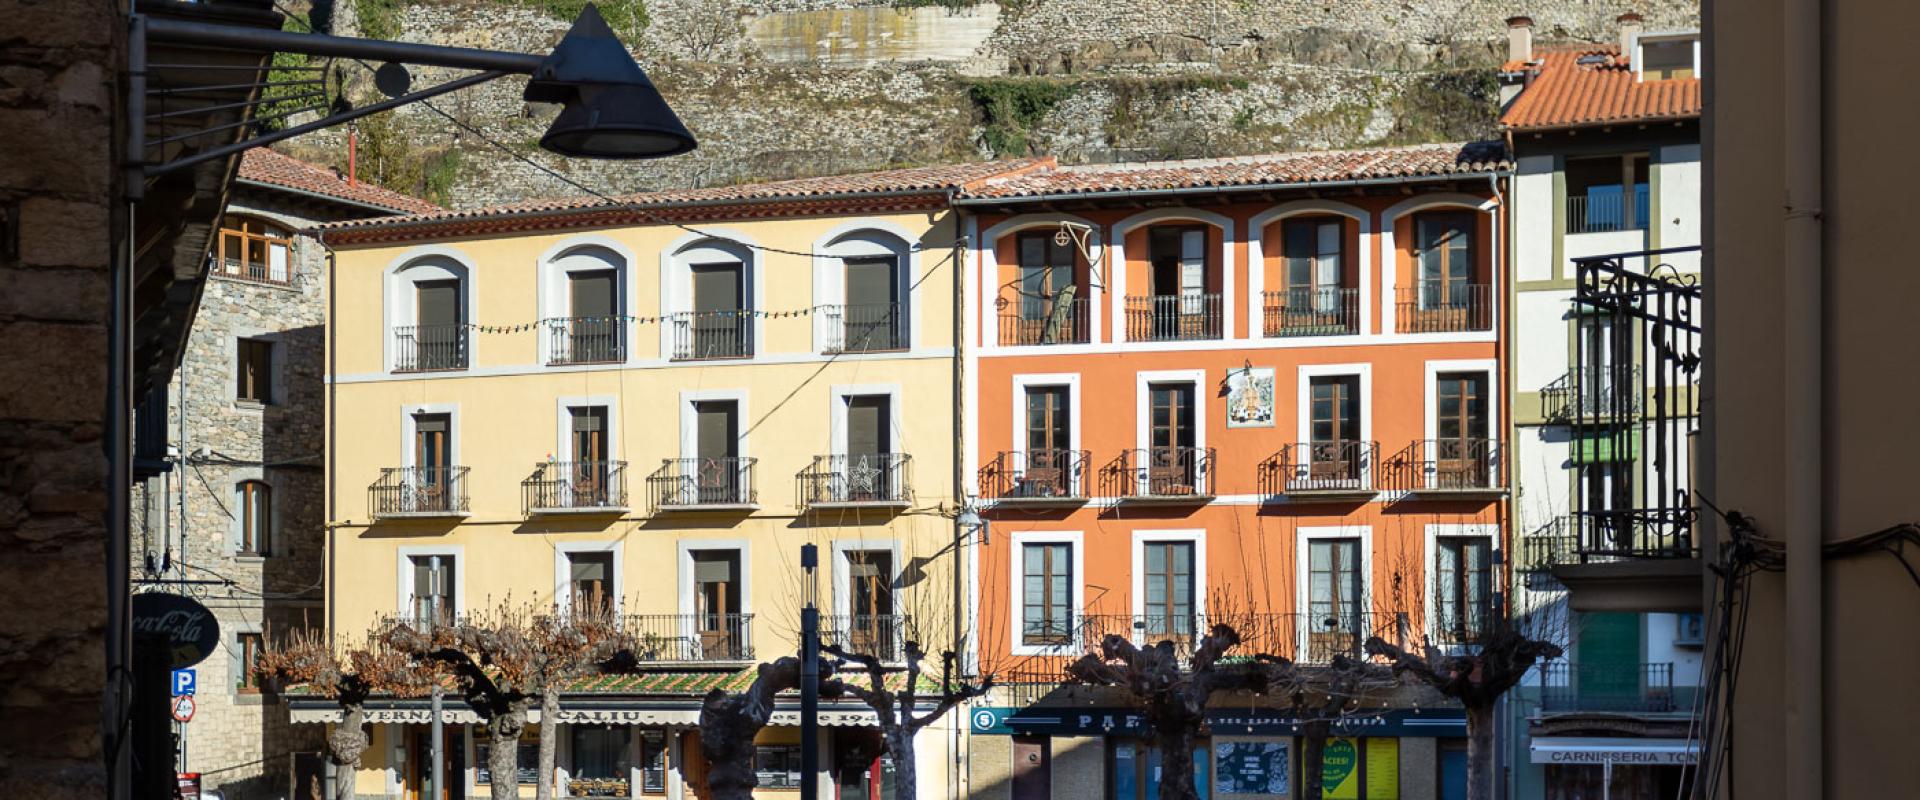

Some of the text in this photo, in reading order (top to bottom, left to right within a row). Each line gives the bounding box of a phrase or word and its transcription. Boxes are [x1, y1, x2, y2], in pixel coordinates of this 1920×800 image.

[133, 610, 208, 642] ca-Cola
[178, 672, 192, 691] P
[335, 711, 434, 720] TVERN
[1551, 751, 1658, 762] CARNISSERIA
